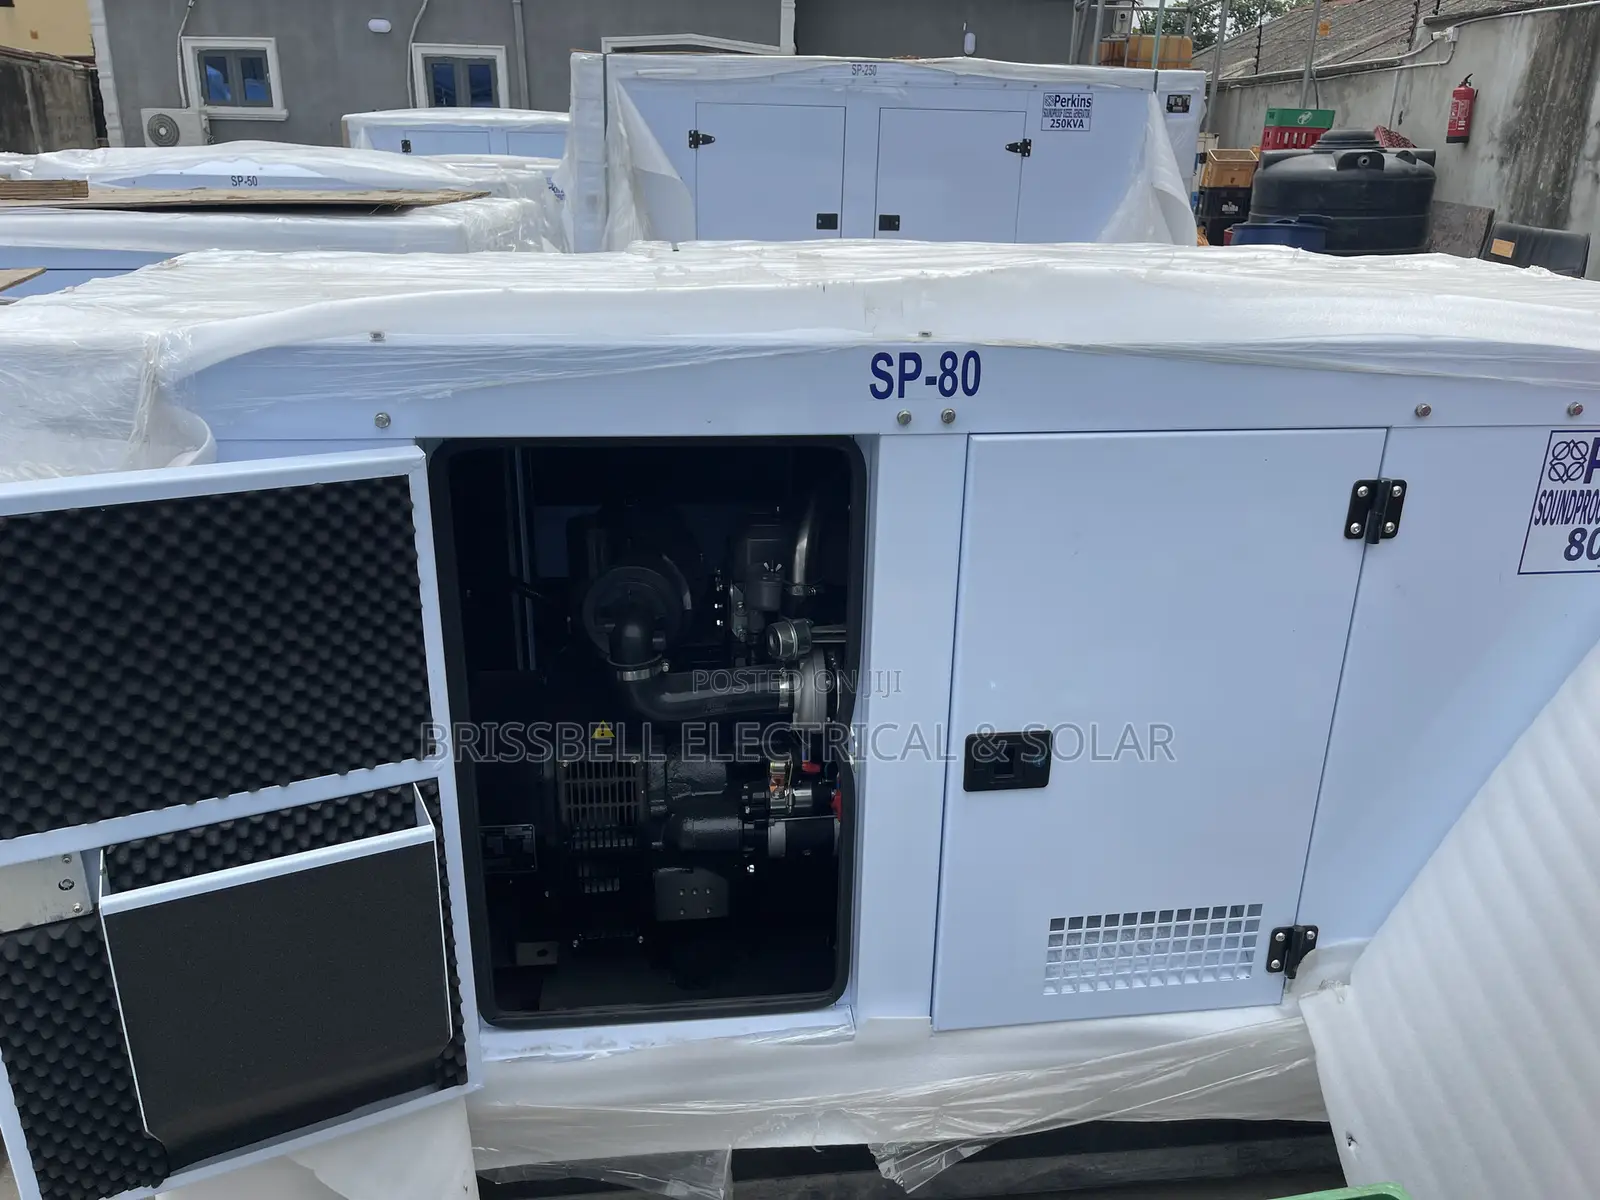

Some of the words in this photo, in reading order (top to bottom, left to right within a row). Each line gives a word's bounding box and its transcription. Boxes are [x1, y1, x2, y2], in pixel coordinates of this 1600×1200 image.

[851, 63, 878, 77] SP-250
[1053, 94, 1092, 108] Perkins
[1050, 118, 1085, 129] 250KVA
[230, 175, 258, 187] SP-50
[869, 349, 981, 400] SP-80
